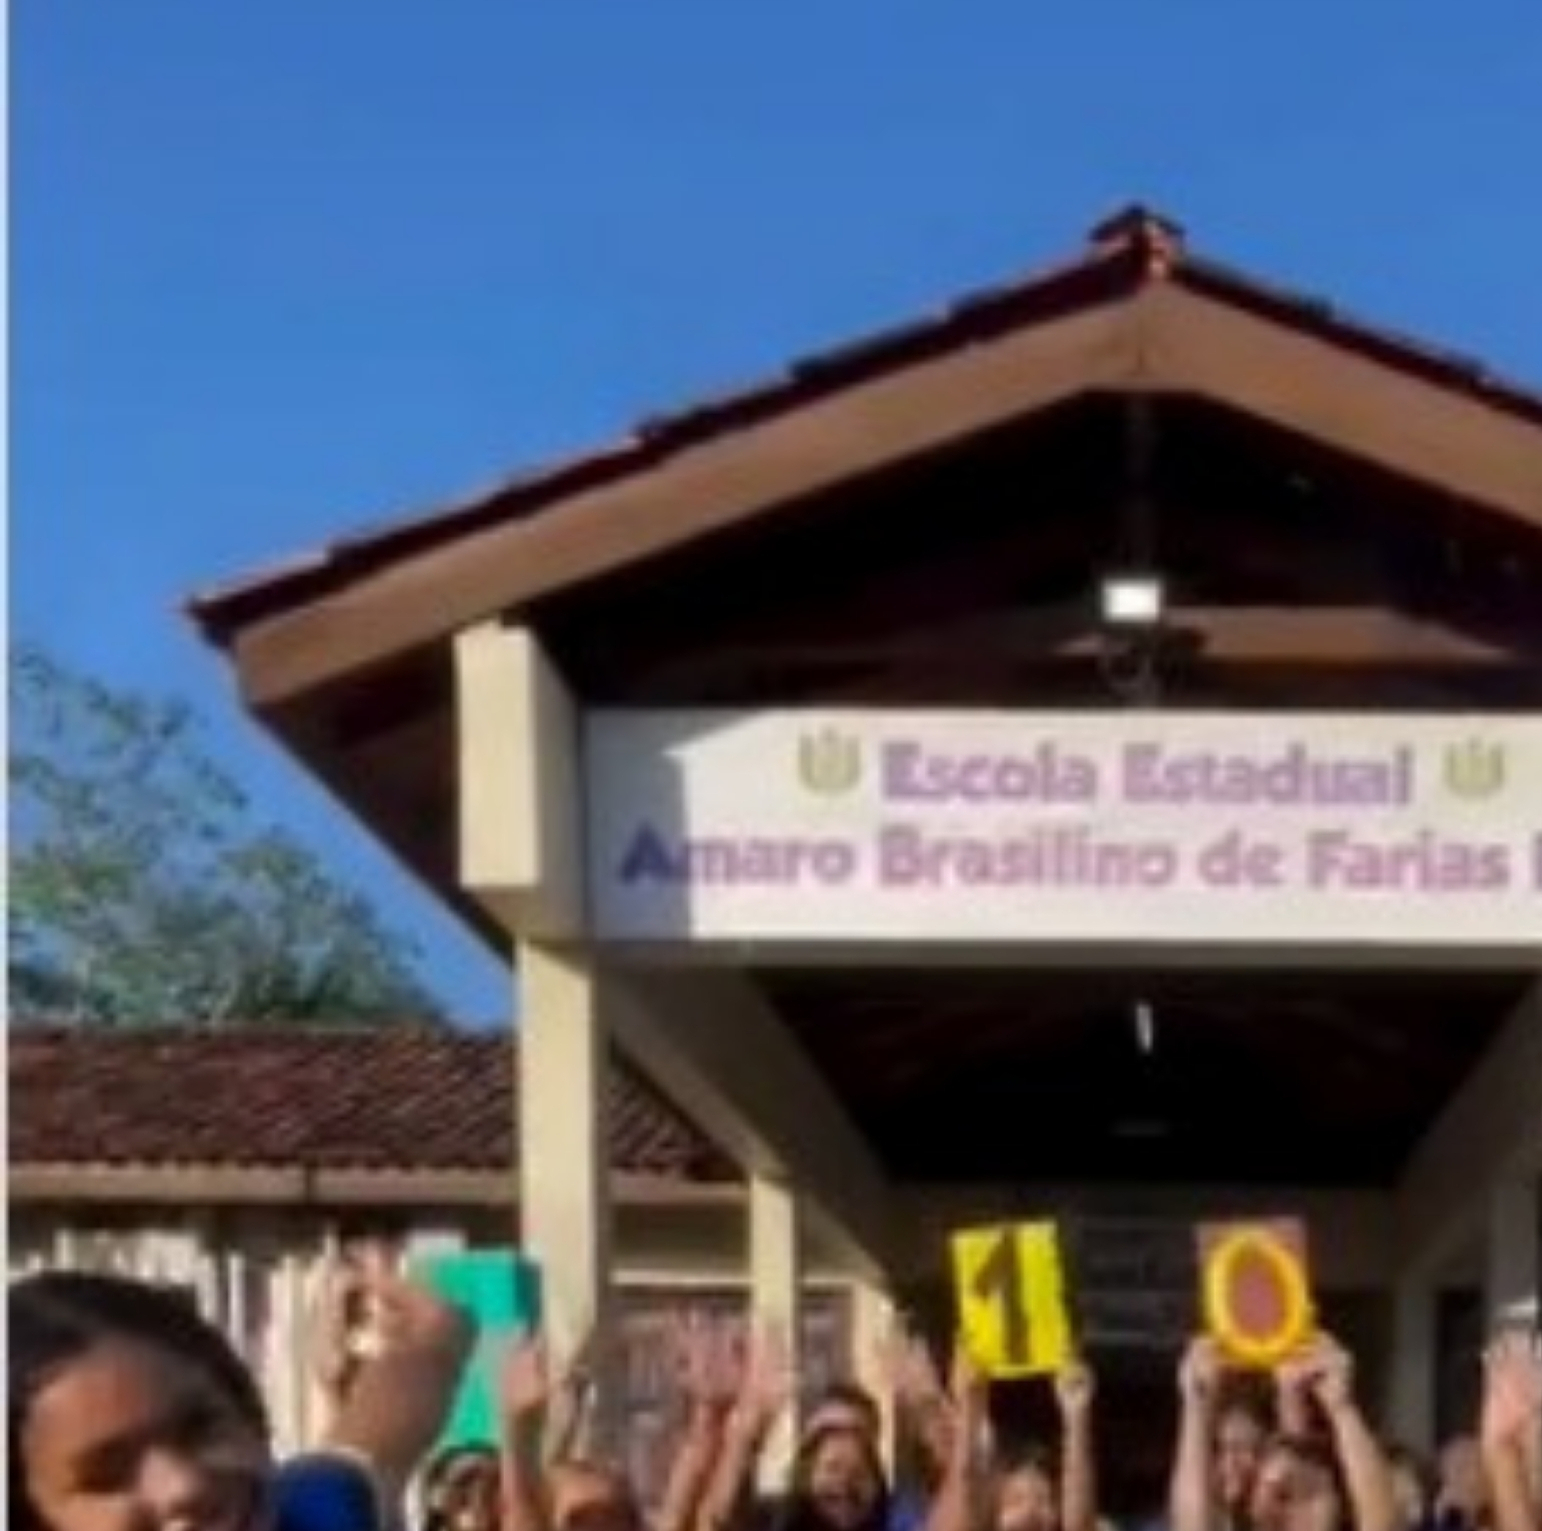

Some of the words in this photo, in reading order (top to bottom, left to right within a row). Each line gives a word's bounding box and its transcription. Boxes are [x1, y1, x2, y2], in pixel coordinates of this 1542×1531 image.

[880, 740, 1098, 803] Escola
[1121, 740, 1412, 804] Estadual
[619, 822, 857, 885] Amaro
[878, 825, 1178, 888] Brasilino
[1198, 829, 1287, 888] de
[1306, 829, 1513, 890] Farias
